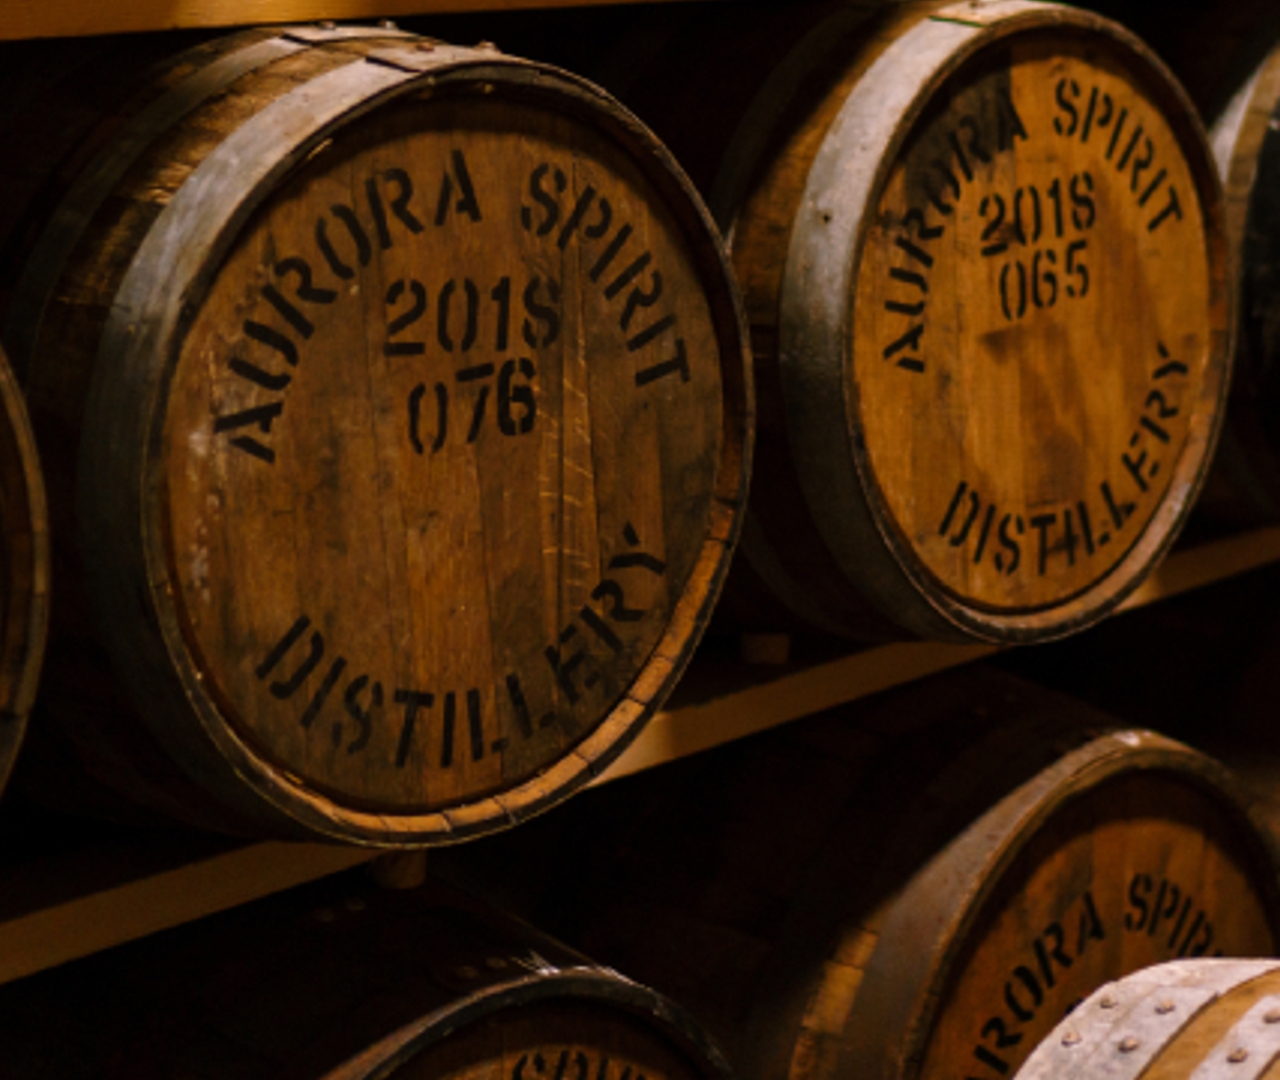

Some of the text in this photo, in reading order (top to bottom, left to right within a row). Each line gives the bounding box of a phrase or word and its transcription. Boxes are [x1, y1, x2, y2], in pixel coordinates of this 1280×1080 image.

[213, 149, 691, 464] AURORA SPIRIT
[884, 78, 1183, 374] AURORA SPIRIT
[999, 240, 1090, 322] 065
[407, 357, 537, 456] 076
[939, 341, 1190, 576] DISTILLERY
[256, 522, 667, 769] DISTILLERY
[966, 873, 1223, 1080] RORA SPIR
